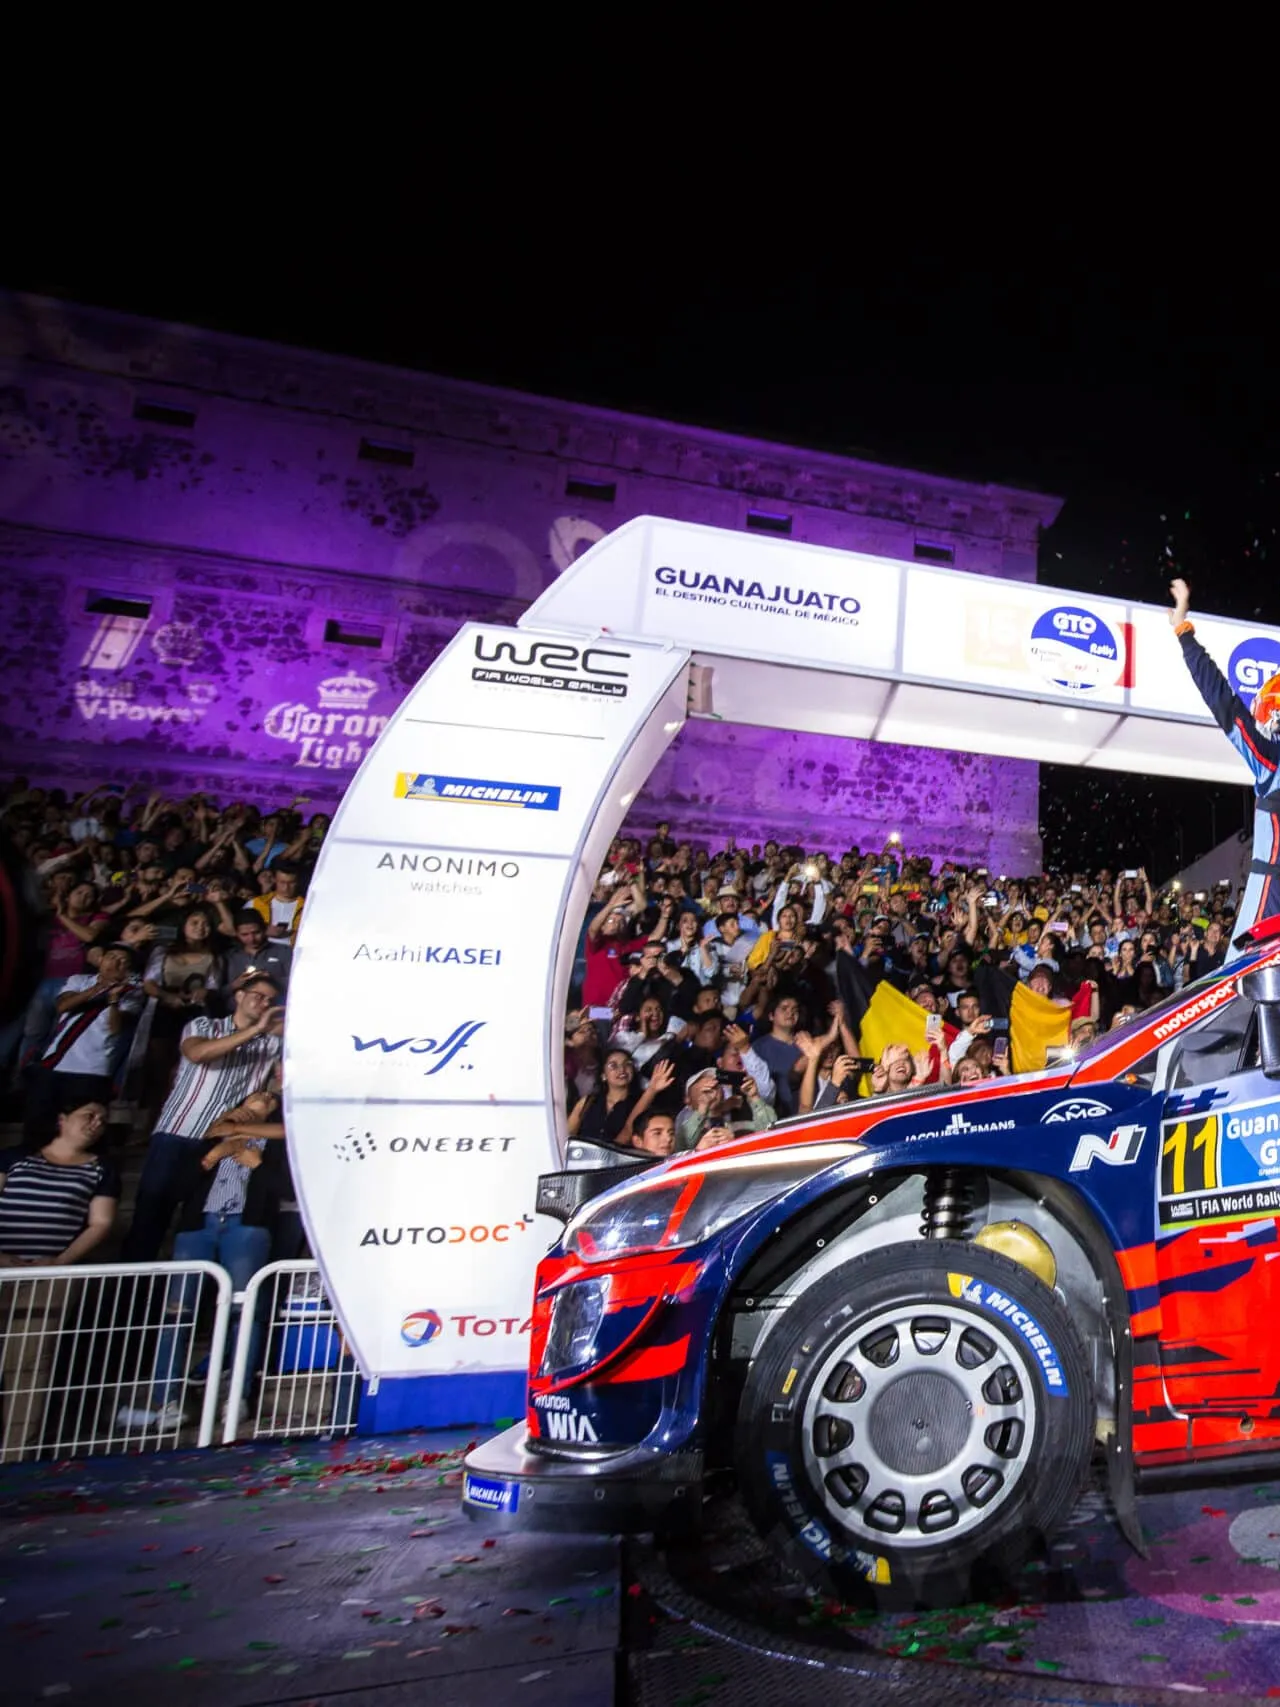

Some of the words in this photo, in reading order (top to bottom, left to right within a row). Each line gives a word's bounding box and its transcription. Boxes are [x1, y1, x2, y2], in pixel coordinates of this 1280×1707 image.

[654, 566, 861, 614] GUANAJUATO
[655, 587, 669, 597] EL
[672, 590, 727, 606] DESTINO
[729, 598, 791, 616] CULTURAL
[794, 609, 810, 619] DE
[1053, 612, 1097, 634] GTO
[475, 635, 632, 677] WRC
[475, 670, 502, 681] FIA
[505, 673, 564, 688] WORLD
[568, 681, 624, 695] RALLY
[264, 702, 393, 743] Coron
[294, 736, 367, 769] Ligh
[441, 784, 549, 804] MICHELIN
[377, 852, 520, 878] ANONIMO
[411, 880, 483, 896] watches
[1153, 976, 1236, 1039] motorspor
[389, 1137, 516, 1152] ONEBET
[1163, 1115, 1218, 1193] 11
[1201, 1199, 1220, 1215] FIA
[1221, 1194, 1253, 1212] World
[360, 1224, 511, 1247] AUTODOC
[450, 1315, 533, 1337] TOTA
[985, 1291, 1063, 1386] MICHELIN
[535, 1394, 570, 1411] HYUNDAI
[470, 1485, 512, 1504] MICHELIN
